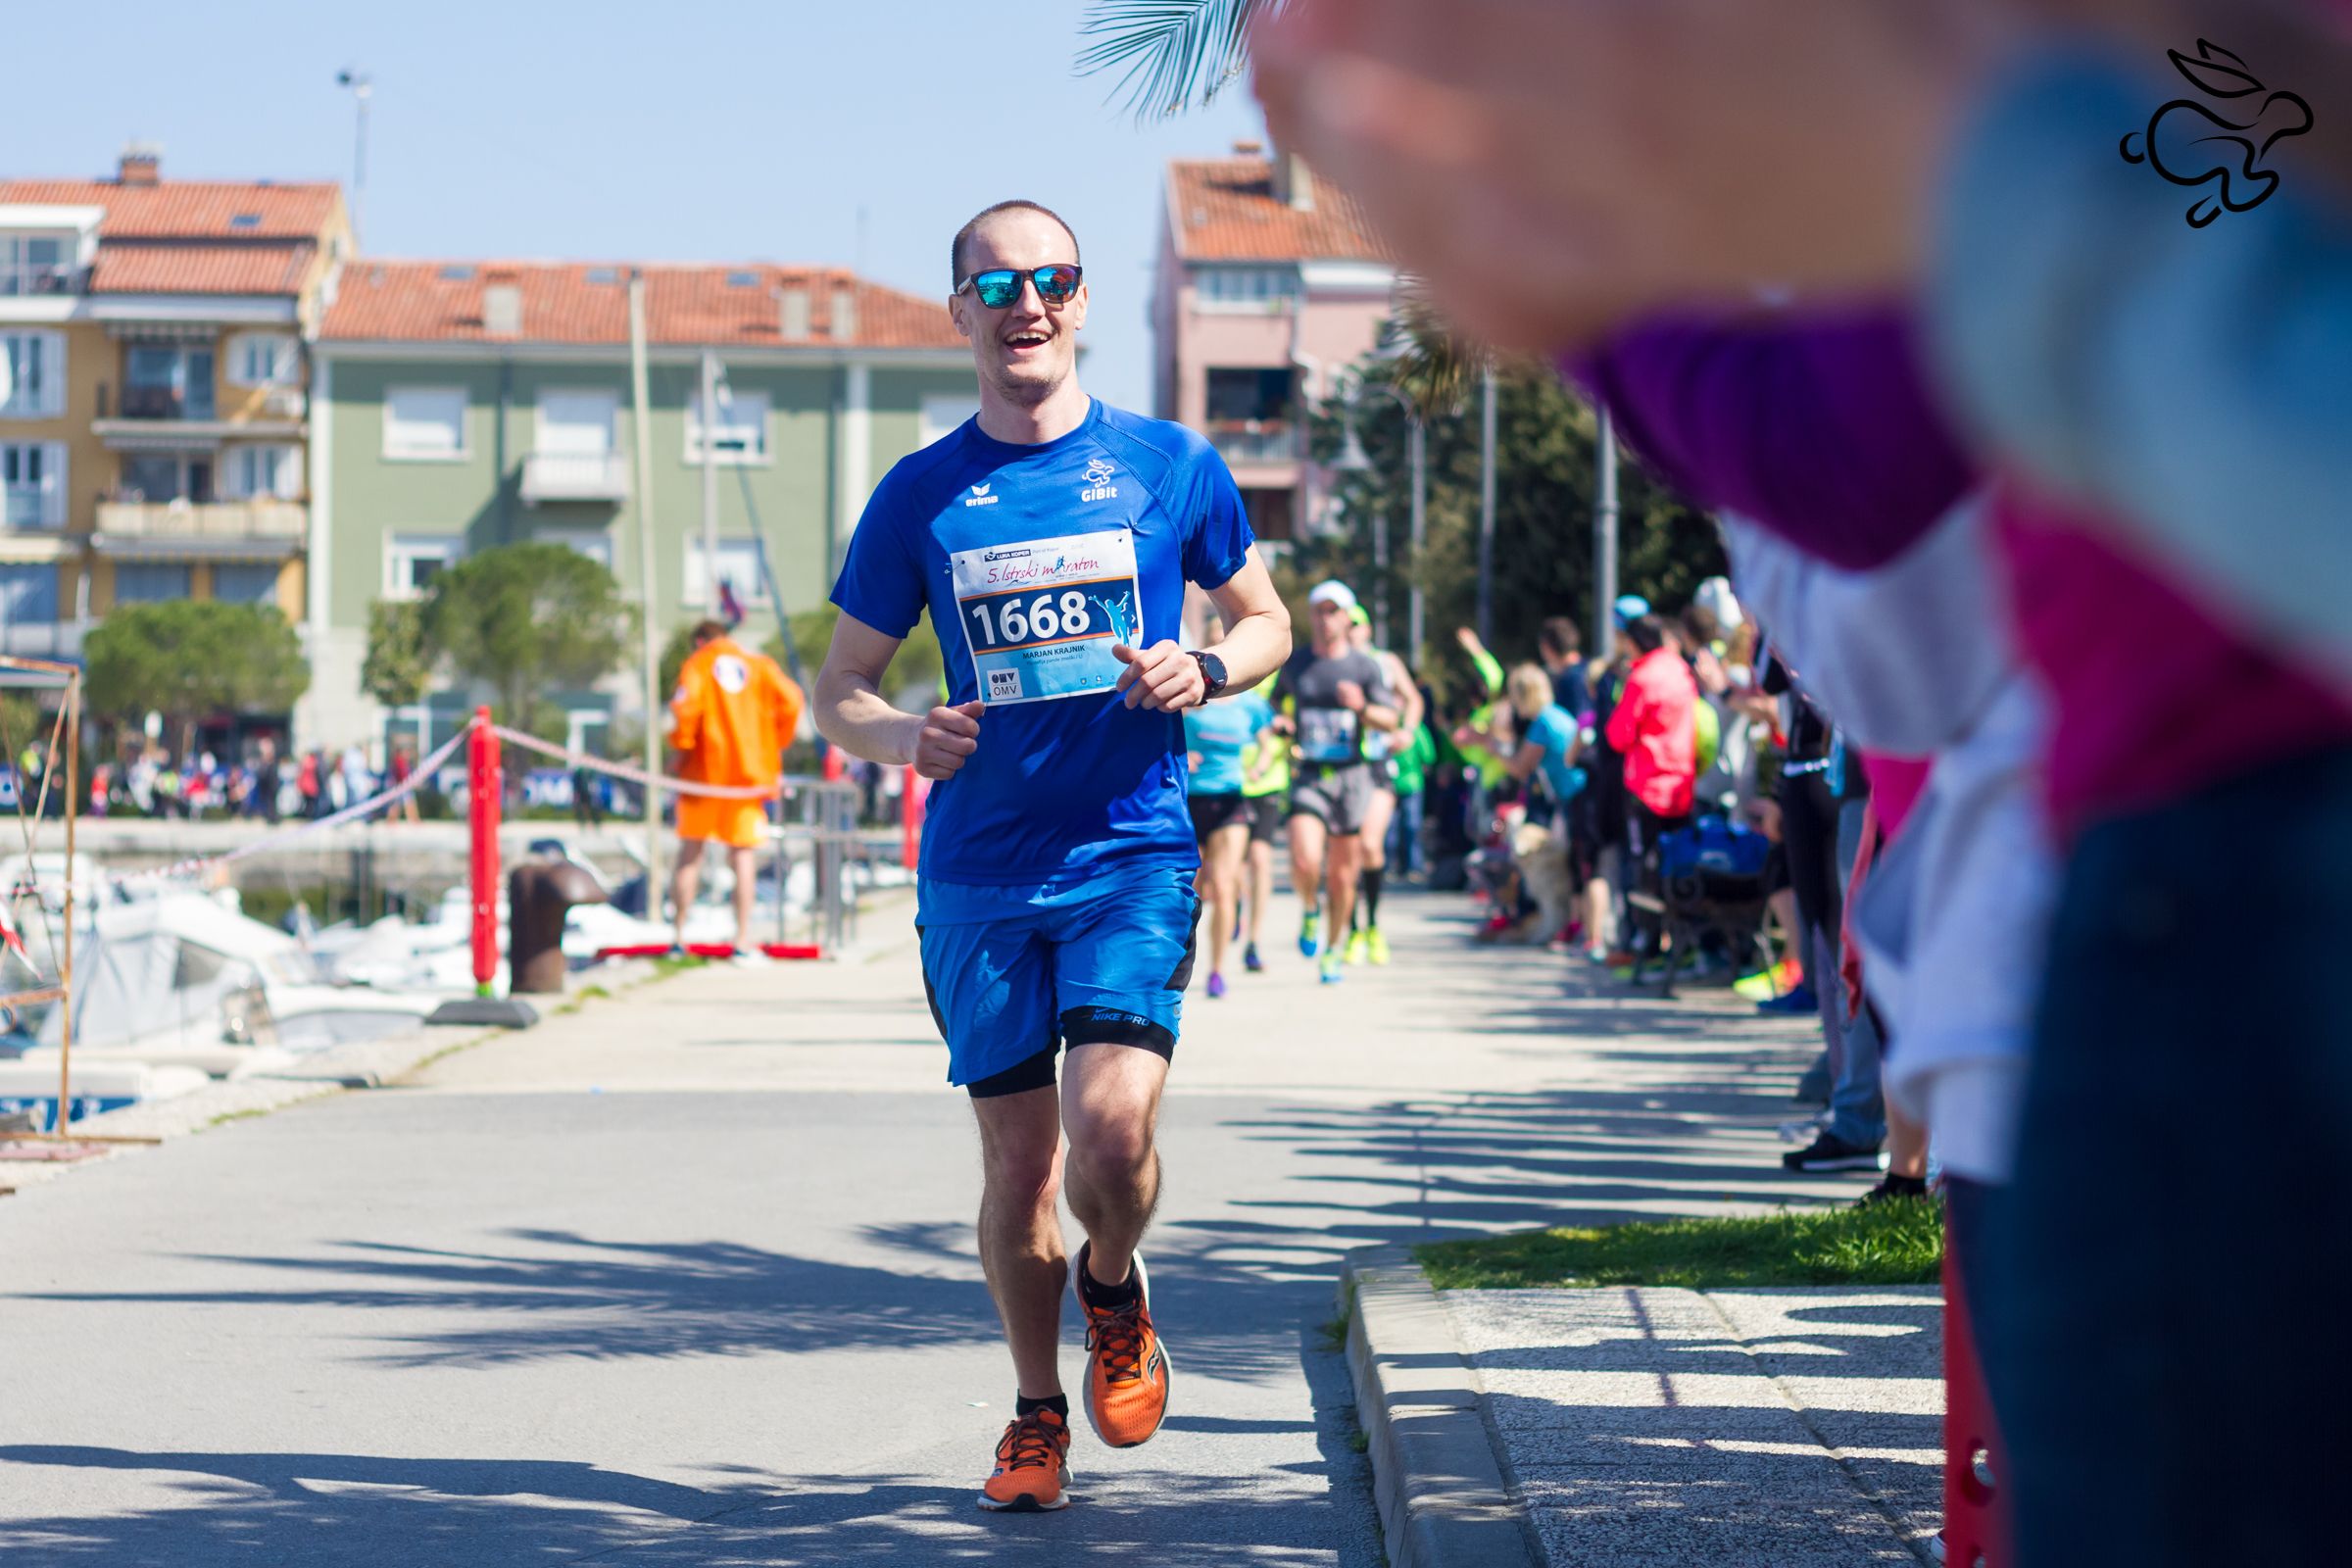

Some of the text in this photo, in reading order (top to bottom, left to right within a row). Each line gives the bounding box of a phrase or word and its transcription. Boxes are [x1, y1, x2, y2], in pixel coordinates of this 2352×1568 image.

[965, 495, 999, 508] erima
[972, 591, 1091, 645] 1668
[1022, 644, 1086, 660] MARJAN KRAJNIK
[993, 685, 1017, 696] OMV
[1091, 1012, 1151, 1026] NIKE PRO
